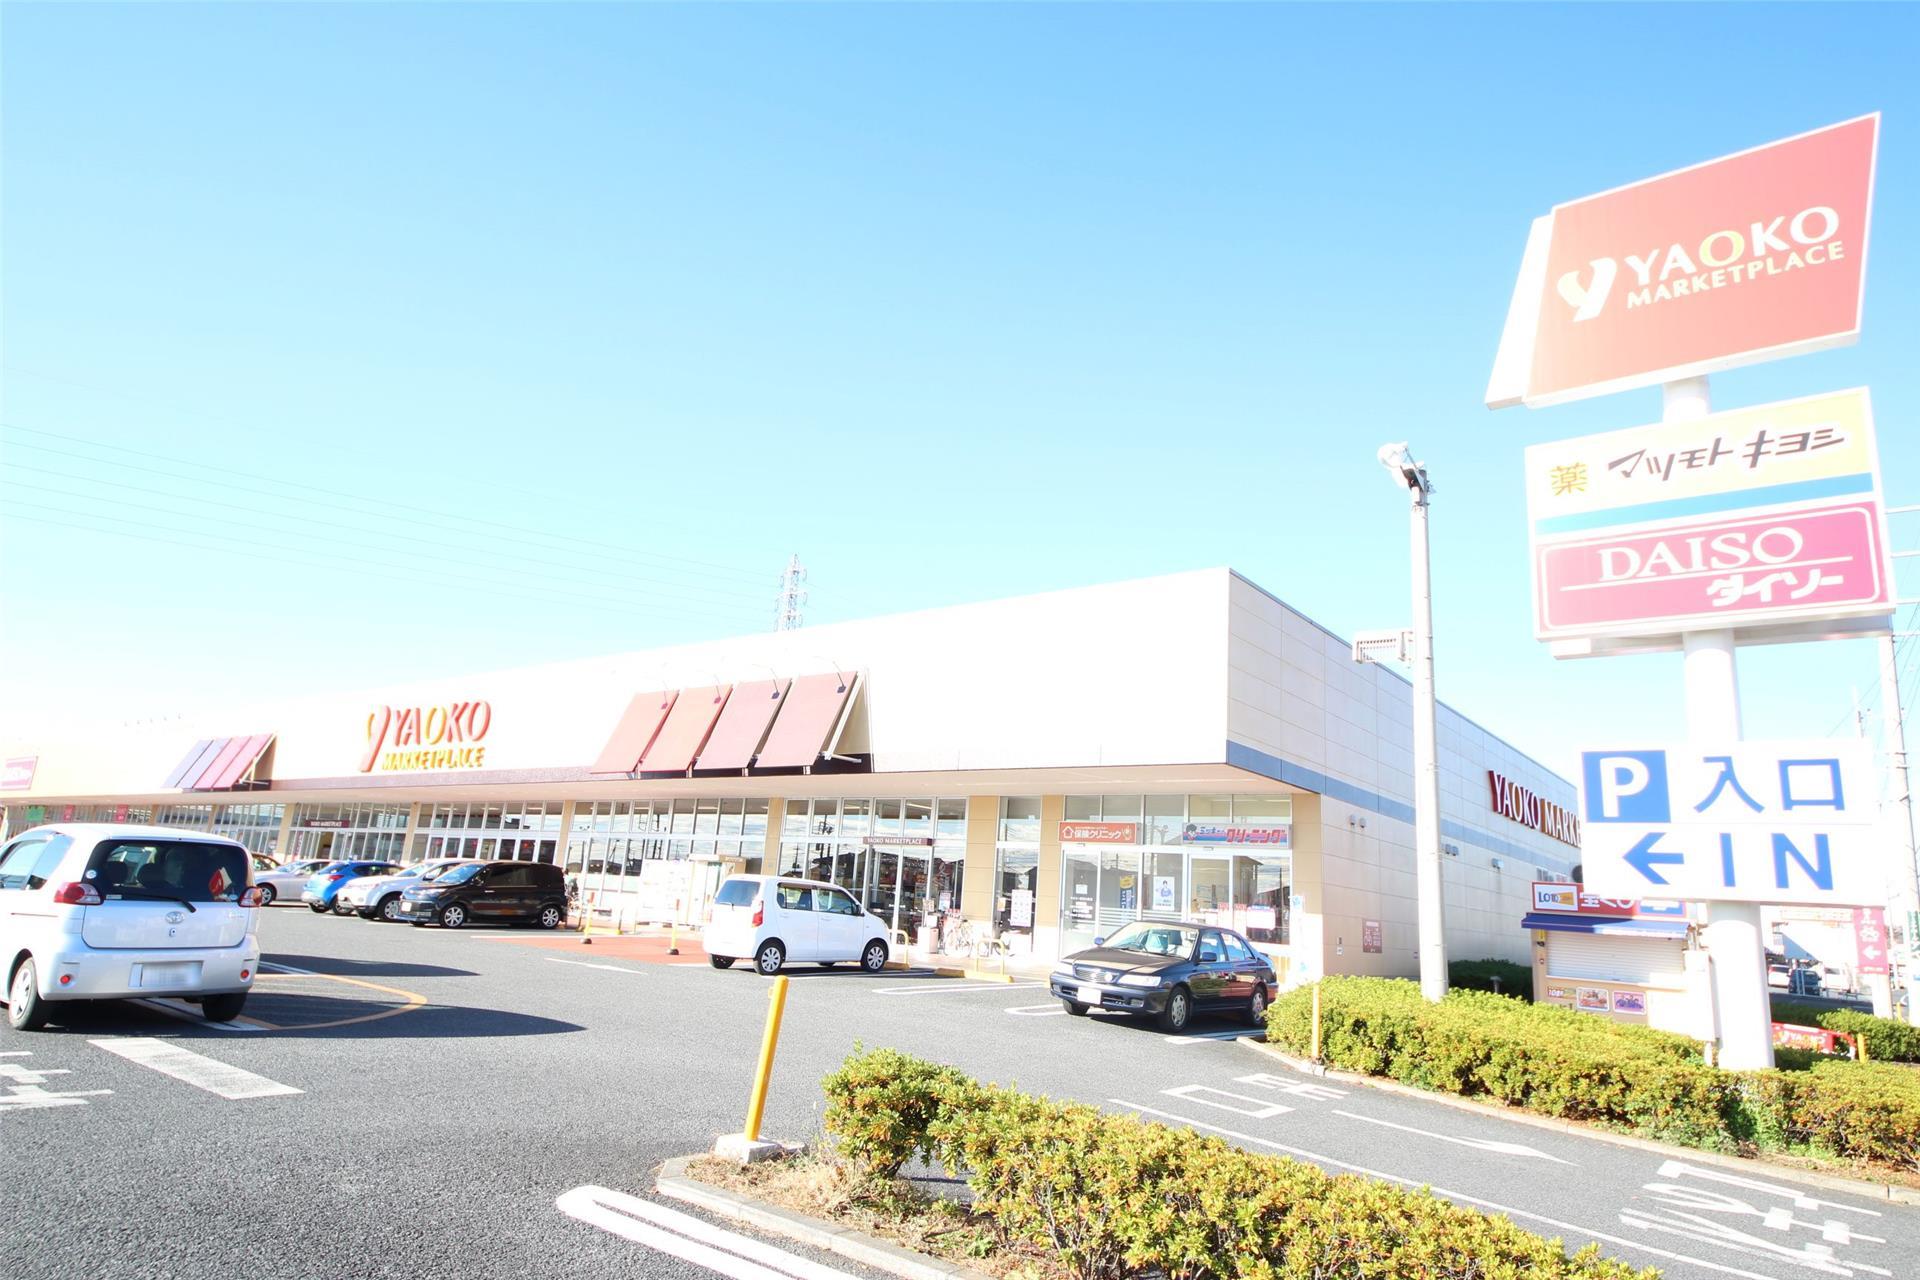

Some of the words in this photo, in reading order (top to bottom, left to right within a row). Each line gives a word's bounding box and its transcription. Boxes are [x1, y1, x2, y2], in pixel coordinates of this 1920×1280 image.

[1624, 205, 1840, 287] YAOKO
[1626, 241, 1845, 309] MARKETPLACE
[1550, 462, 1589, 496] 薬
[1607, 429, 1845, 481] マツモトキヨシ
[1599, 526, 1803, 580] DAISO
[1706, 568, 1844, 607] ダイソー
[393, 700, 492, 748] YAOKO
[381, 746, 486, 771] MARKETPLACE
[1600, 757, 1650, 818] P
[1693, 755, 1846, 814] 入口
[1488, 770, 1541, 830] YAOKO
[1540, 797, 1582, 849] MARKE
[1719, 831, 1834, 890] IN
